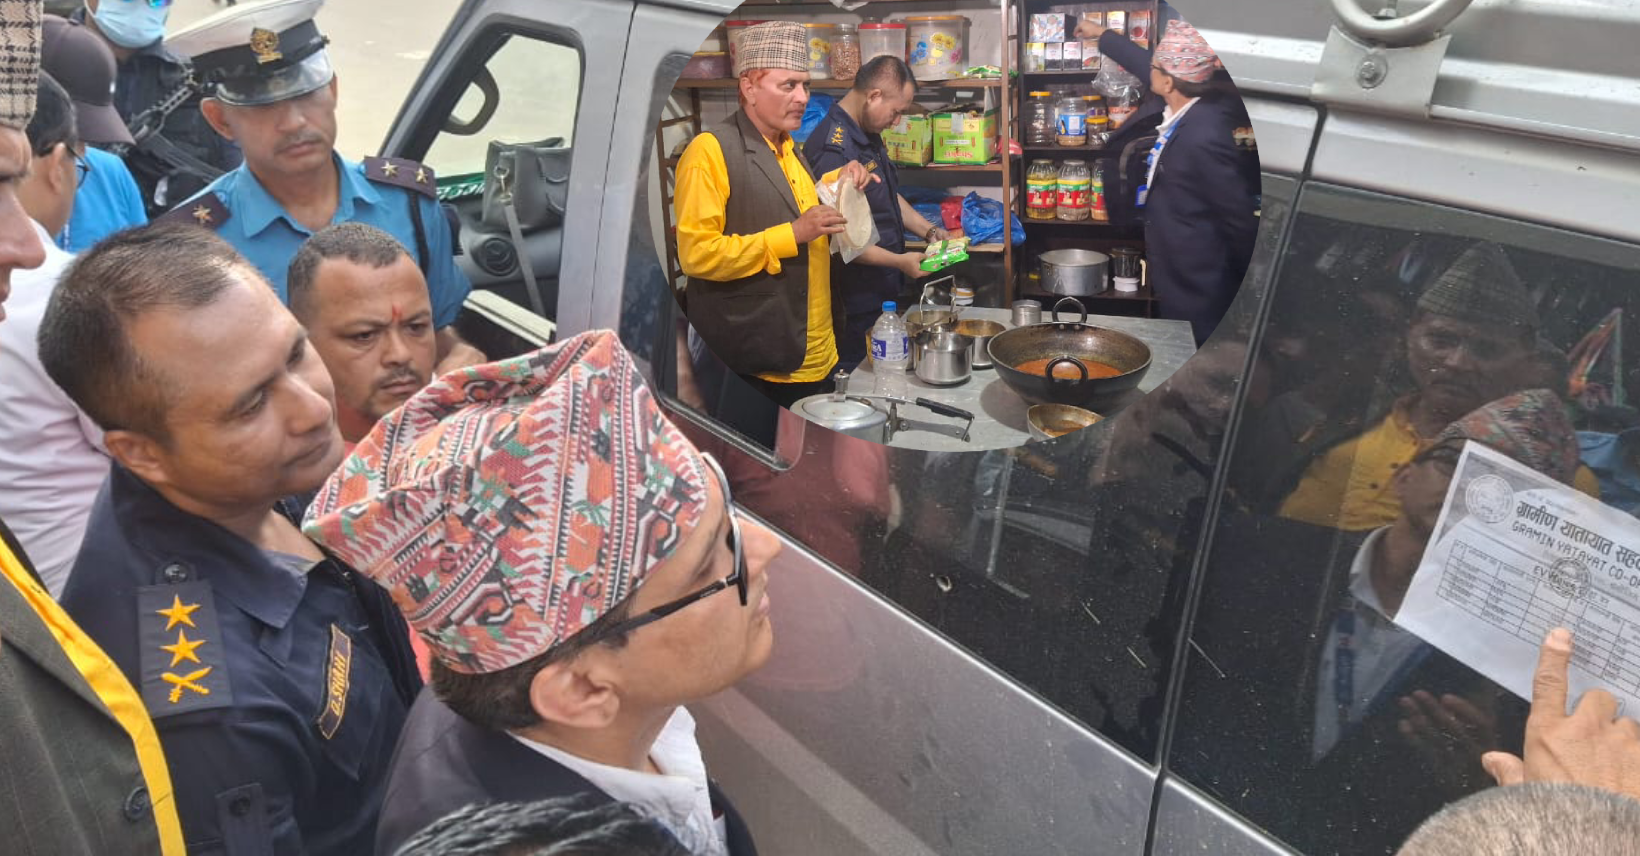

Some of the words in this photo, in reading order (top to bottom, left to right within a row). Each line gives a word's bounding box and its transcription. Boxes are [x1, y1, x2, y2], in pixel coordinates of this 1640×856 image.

[1512, 521, 1555, 548] GRAMIN
[1557, 541, 1607, 571] YATAYAT
[1516, 501, 1559, 531] ग्रामीण
[1560, 520, 1615, 556] यातायात
